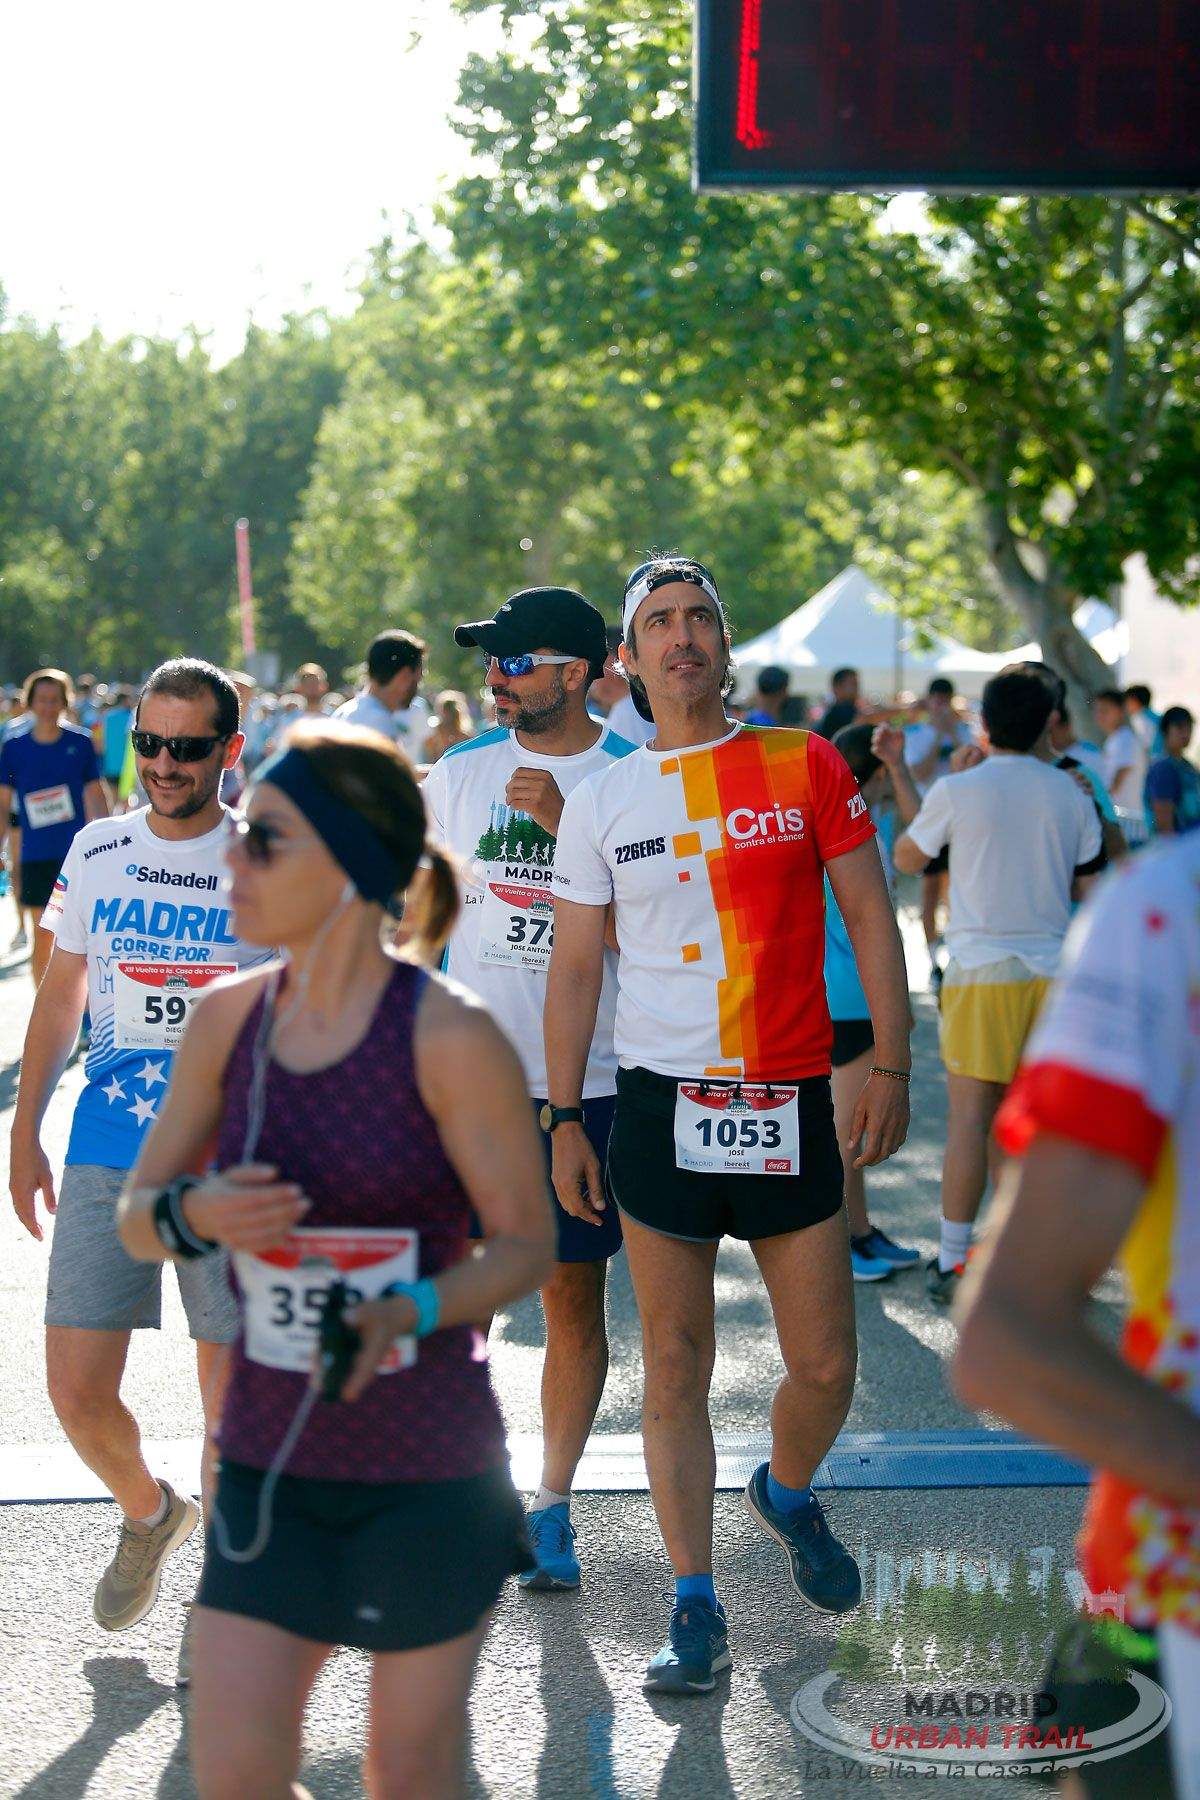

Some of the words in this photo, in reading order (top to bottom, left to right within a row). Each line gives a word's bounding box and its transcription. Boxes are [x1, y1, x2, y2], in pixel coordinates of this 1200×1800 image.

[726, 803, 804, 840] Cris
[615, 836, 666, 865] 226ERS
[734, 837, 765, 850] contra
[767, 834, 776, 845] el
[777, 832, 805, 844] cáncer
[136, 866, 218, 891] Sabadell
[505, 866, 553, 883] MADR
[504, 888, 526, 896] Vuelta
[111, 937, 171, 961] CORRE
[174, 945, 212, 962] POR
[510, 944, 525, 952] JOSE
[526, 946, 551, 955] ANTON
[135, 966, 158, 974] Vuelta
[144, 995, 190, 1025] 59
[756, 1090, 765, 1098] de
[695, 1118, 782, 1149] 1053
[270, 1284, 363, 1328] 35
